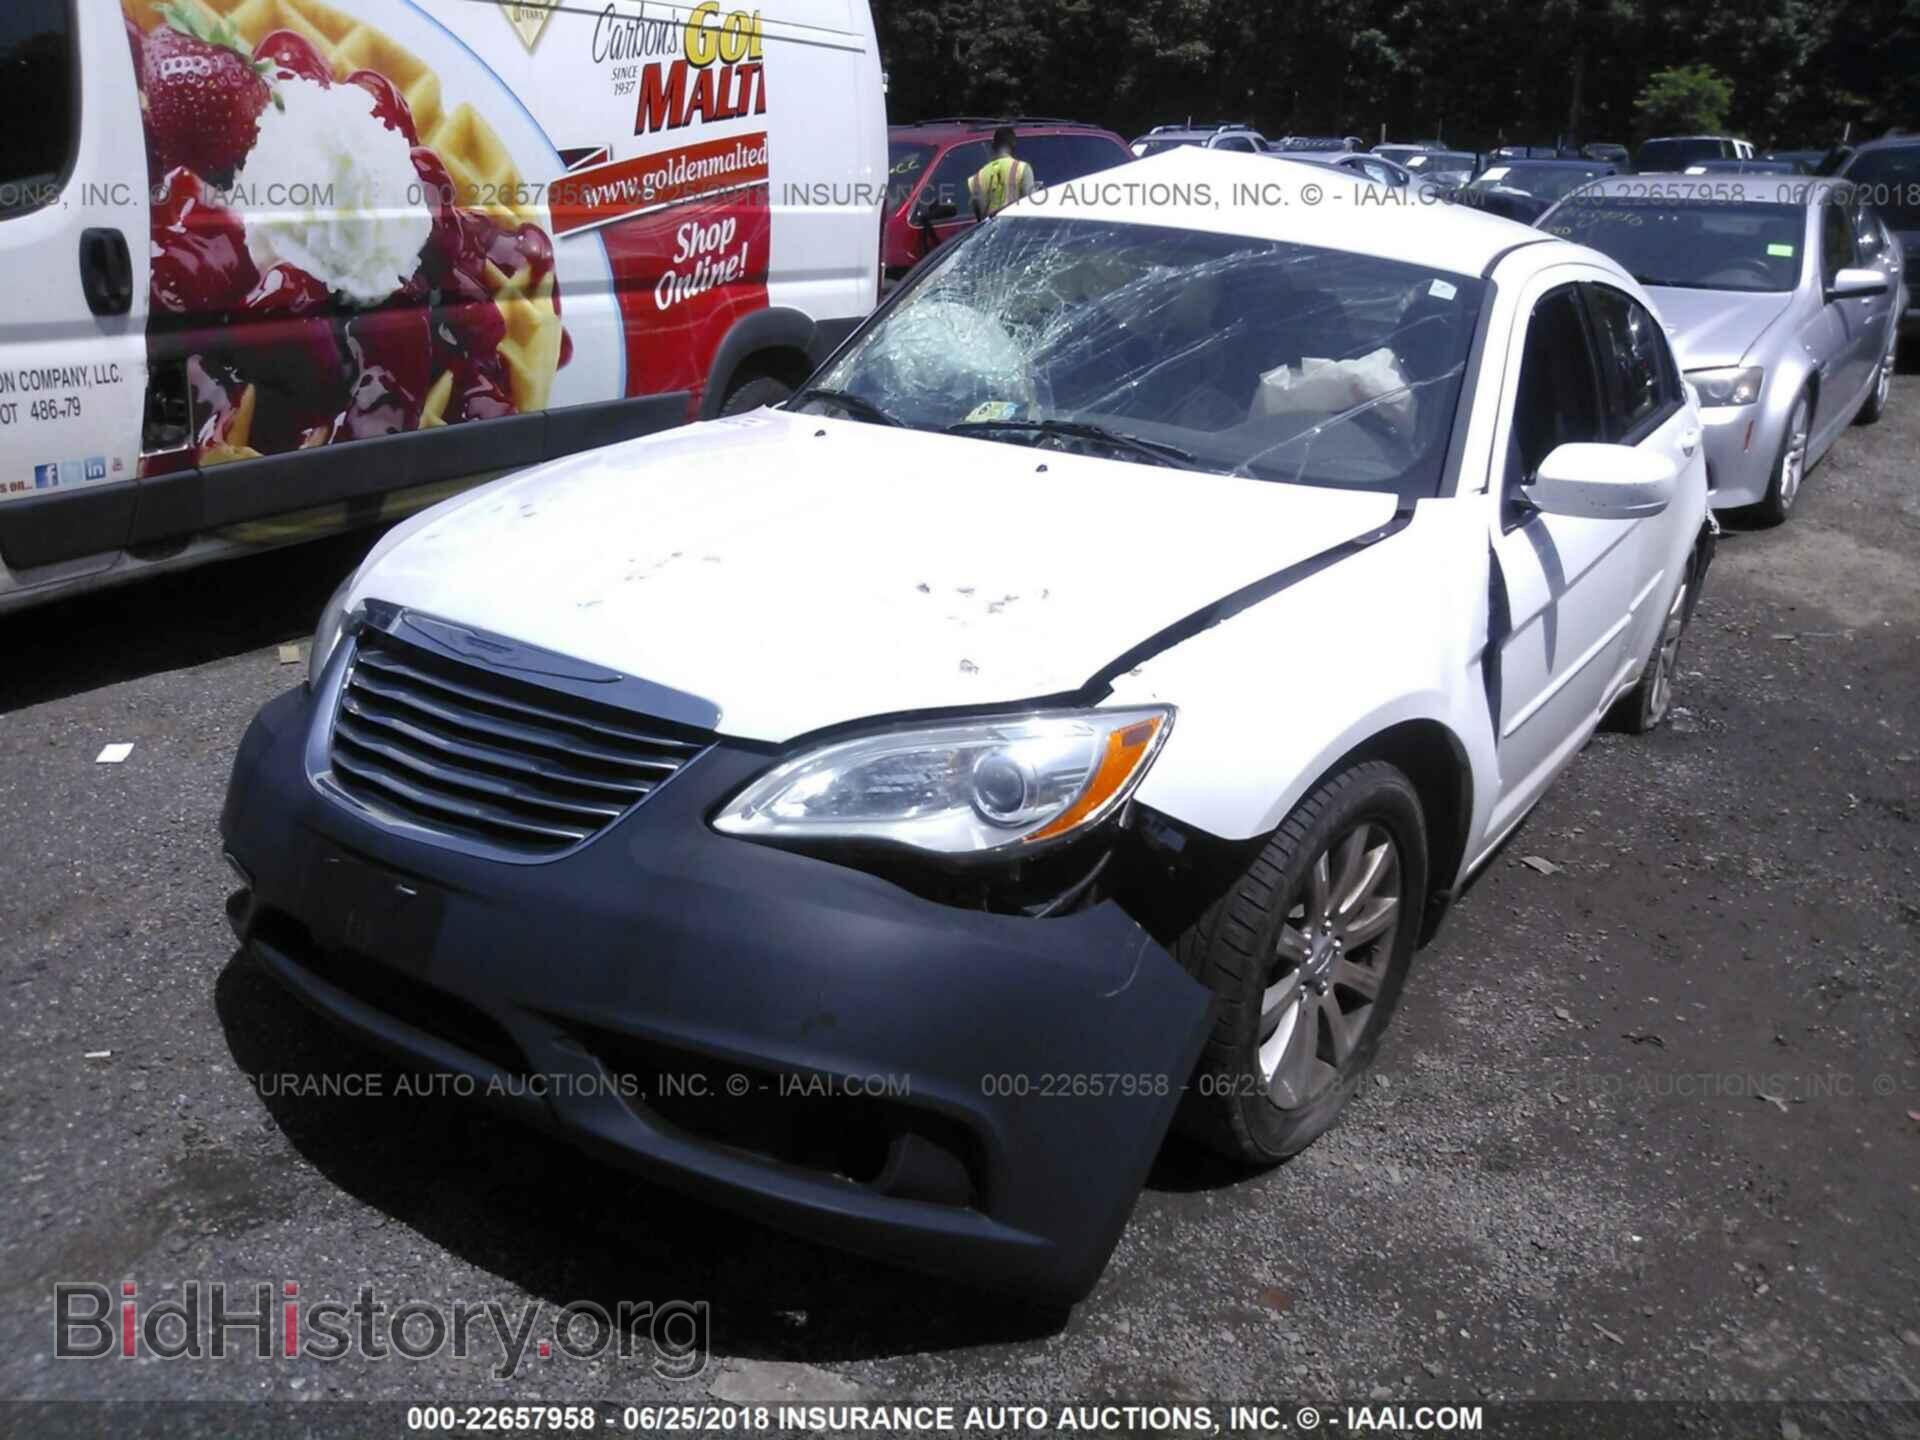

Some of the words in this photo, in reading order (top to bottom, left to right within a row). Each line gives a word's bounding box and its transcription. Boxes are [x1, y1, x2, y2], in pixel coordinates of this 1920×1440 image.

[592, 1, 680, 64] Carbon's
[611, 64, 639, 81] SINCE
[613, 80, 637, 96] 1937
[584, 138, 769, 209] www.goldenmalted
[672, 216, 738, 264] Shop
[654, 242, 749, 311] Online!
[19, 365, 92, 391] COMPANY,
[93, 363, 123, 385] LLC.
